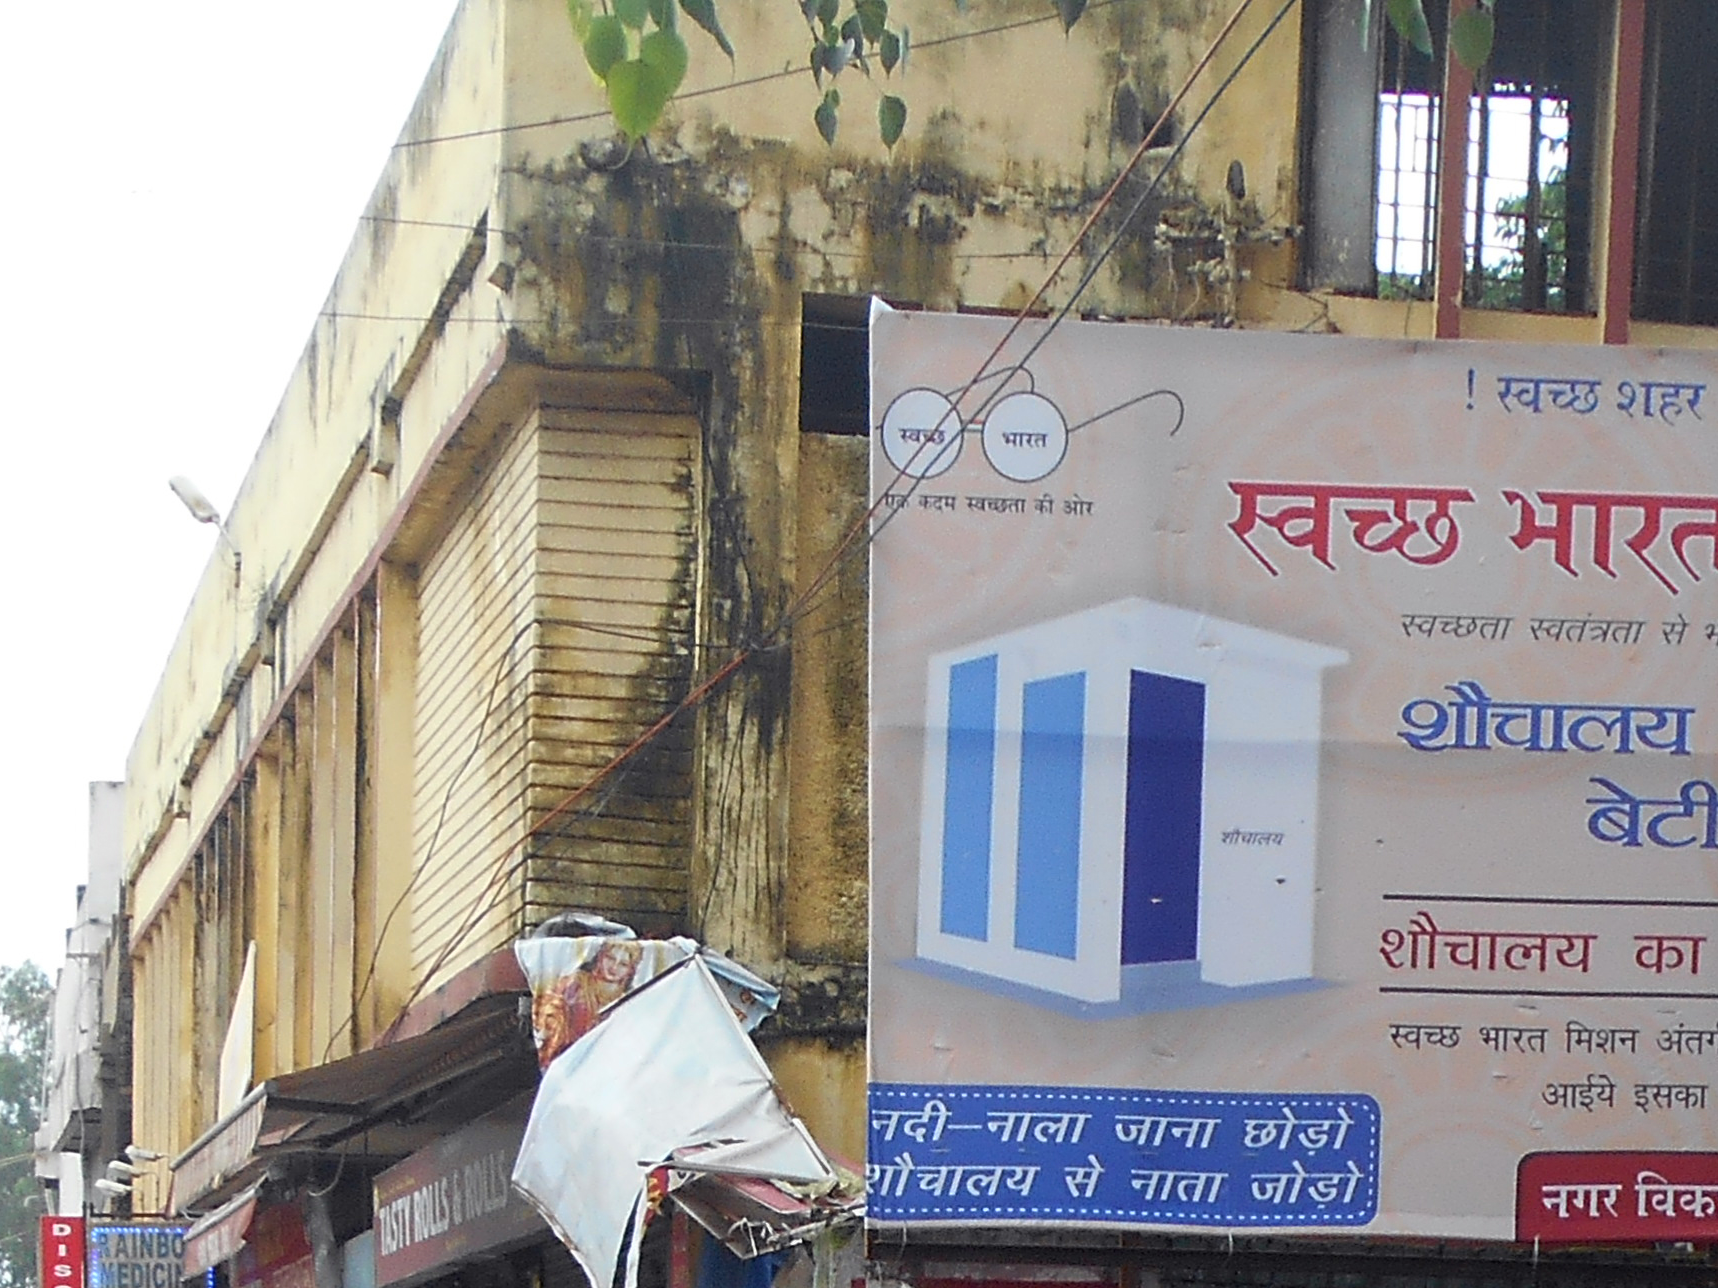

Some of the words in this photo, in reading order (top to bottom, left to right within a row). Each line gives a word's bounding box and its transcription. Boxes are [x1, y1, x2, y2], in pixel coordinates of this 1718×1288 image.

[1497, 374, 1602, 416] स्वच्छ
[1617, 378, 1707, 422] शहर
[897, 427, 948, 446] स्वच्छ
[1001, 429, 1048, 450] भारत
[917, 494, 956, 511] कदम
[966, 495, 1026, 515] स्वच्छता
[1032, 494, 1055, 516] की
[1062, 496, 1095, 518] ओर
[1226, 480, 1477, 578] स्वच्छ
[1399, 613, 1514, 641] स्वच्छता
[1529, 611, 1649, 645] स्वतंत्रता
[1661, 613, 1687, 647] से
[1398, 680, 1697, 756] शौचालय
[1220, 828, 1285, 848] शौचालय
[1378, 910, 1598, 973] शौचालय
[1633, 932, 1707, 975] का
[1389, 1022, 1462, 1051] स्वच्छ
[1478, 1024, 1549, 1055] भारत
[1563, 1021, 1641, 1055] मिशन
[1541, 1073, 1617, 1109] आईये
[1633, 1080, 1710, 1111] इसका
[1114, 1113, 1223, 1149] जाना
[1242, 1107, 1355, 1157] छोड़ो
[866, 1153, 1041, 1198] शौचालय
[1064, 1154, 1106, 1198] से
[1129, 1169, 1229, 1203] नाता
[1250, 1155, 1365, 1210] जोड़ो
[1542, 1182, 1621, 1220] नगर
